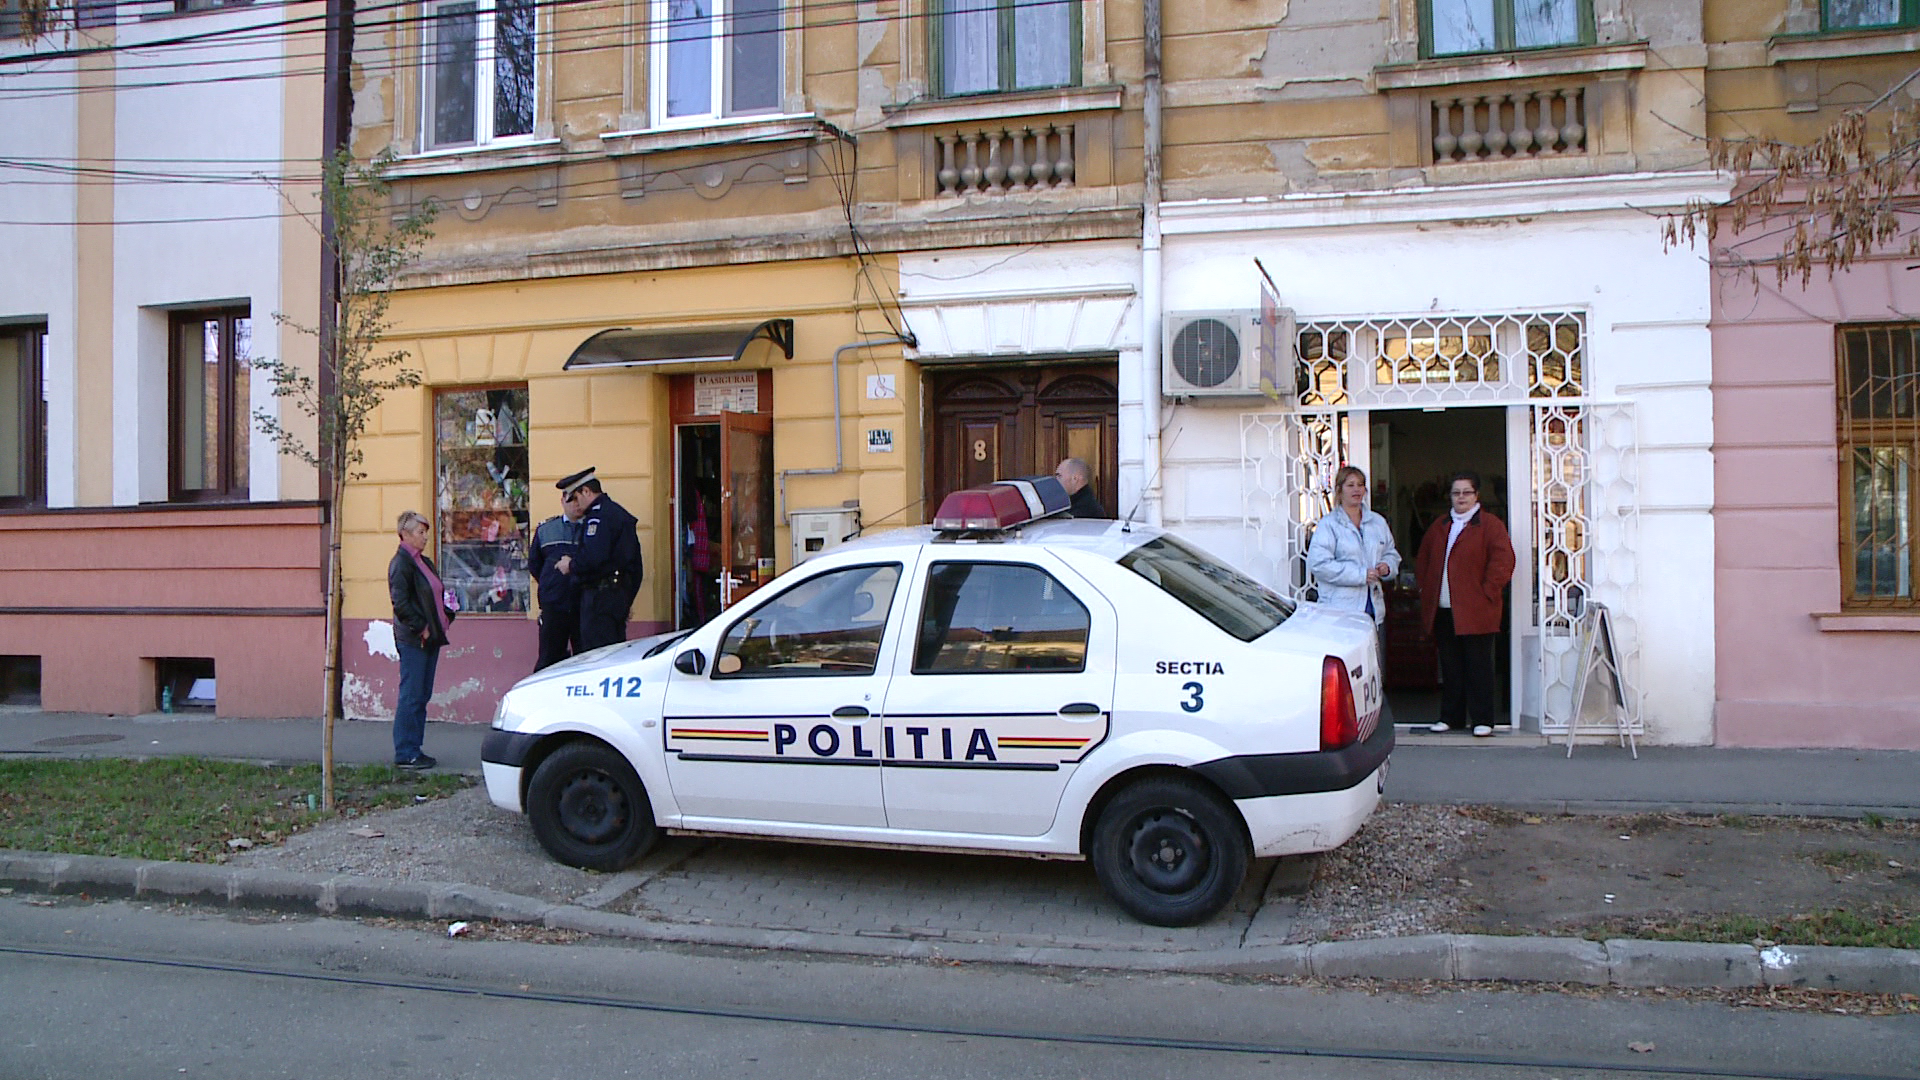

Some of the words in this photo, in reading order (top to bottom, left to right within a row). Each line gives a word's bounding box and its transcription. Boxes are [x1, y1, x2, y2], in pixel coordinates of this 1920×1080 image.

[974, 439, 987, 461] 8
[1155, 661, 1225, 675] SECTIA
[565, 685, 595, 697] TEL.
[599, 676, 642, 698] 112
[1180, 681, 1204, 713] 3
[774, 723, 997, 761] POLITIA
